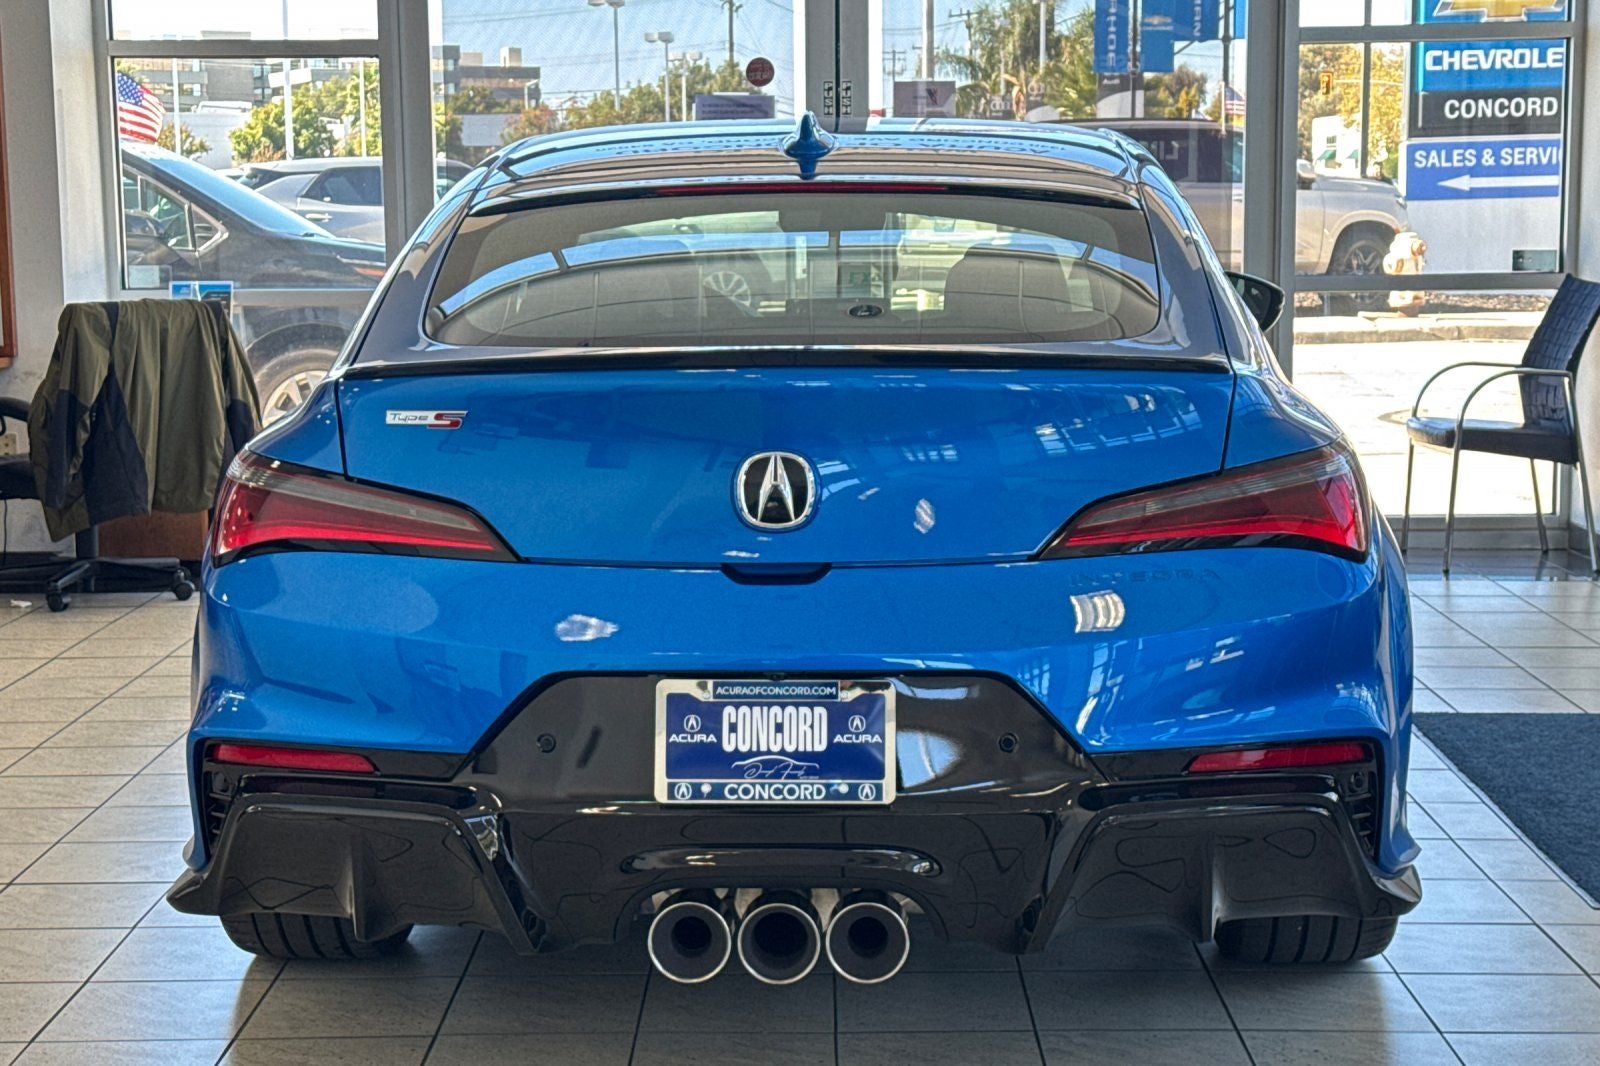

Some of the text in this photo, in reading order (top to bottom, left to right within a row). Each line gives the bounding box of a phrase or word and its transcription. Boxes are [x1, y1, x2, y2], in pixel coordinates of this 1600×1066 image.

[824, 81, 834, 116] PUSH
[842, 81, 852, 116] PUSH
[1444, 97, 1559, 119] CONCORD
[1414, 149, 1477, 168] SALES
[1481, 148, 1497, 166] &
[390, 412, 466, 428] Type S
[715, 686, 837, 696] ACURAOFCONCORD.COM
[669, 733, 718, 743] ACURA
[722, 705, 828, 753] CONCORD
[833, 734, 883, 744] ACURA
[723, 783, 827, 800] CONCORD
